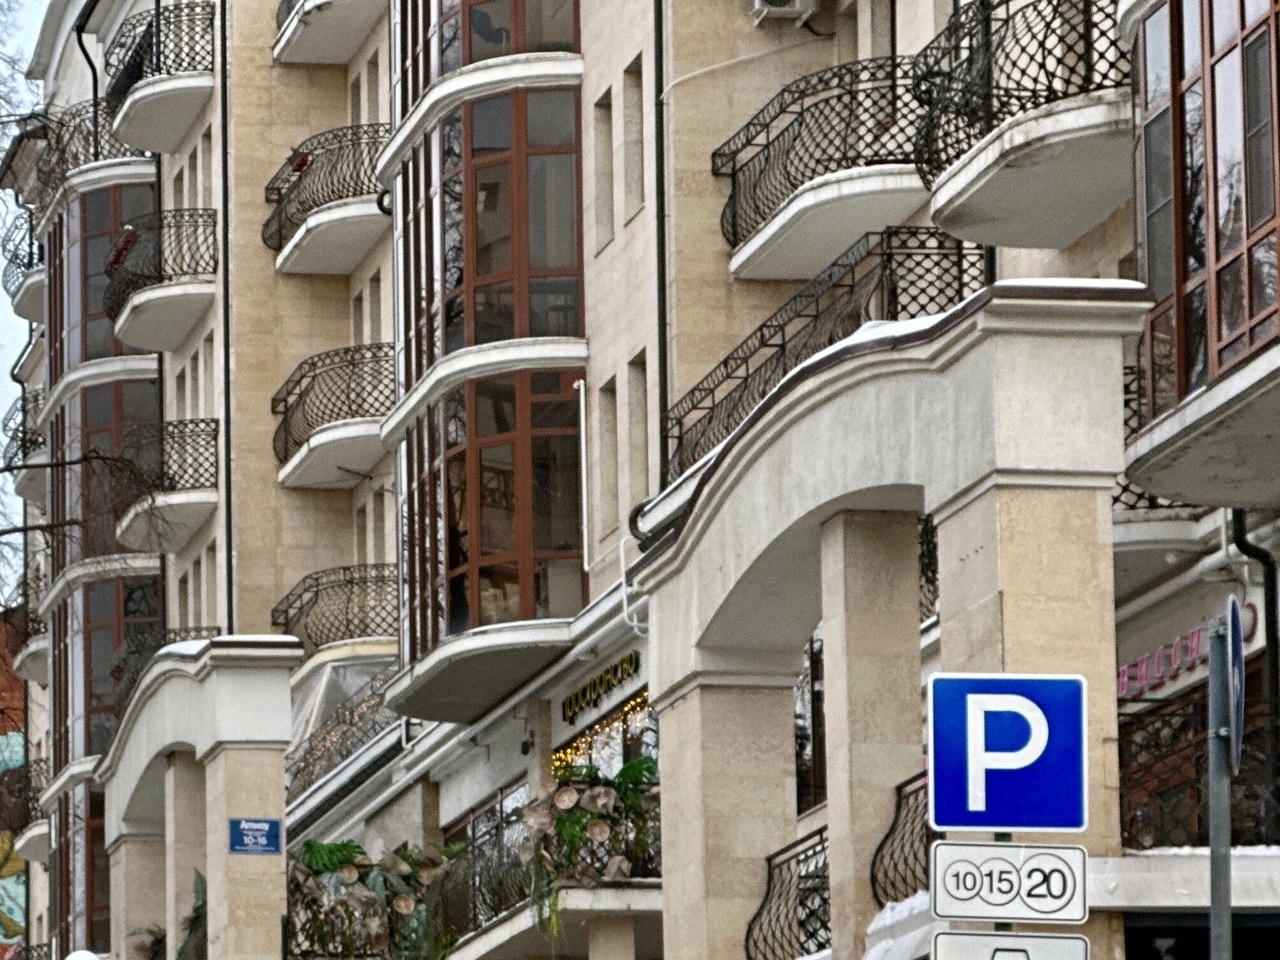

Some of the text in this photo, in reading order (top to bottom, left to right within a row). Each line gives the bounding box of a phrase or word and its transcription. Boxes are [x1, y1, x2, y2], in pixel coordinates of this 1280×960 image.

[965, 693, 1050, 812] P
[951, 868, 1068, 899] 10 15 20
